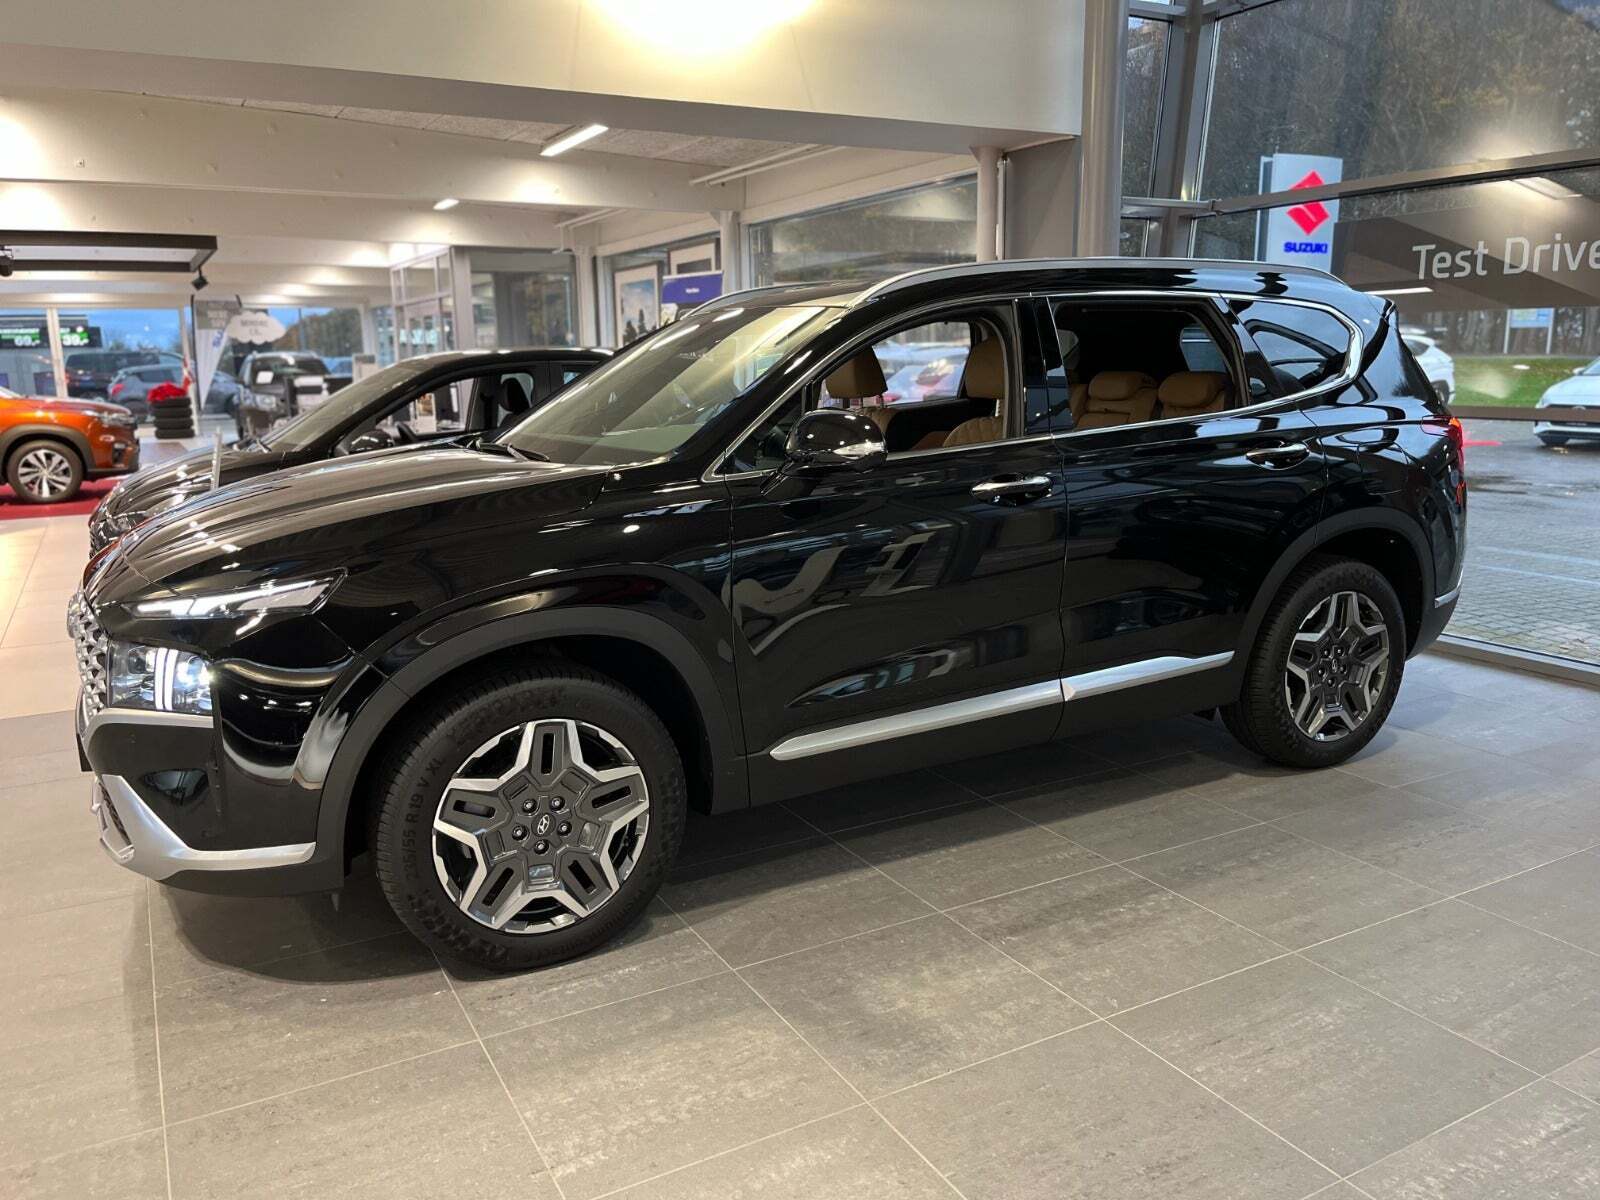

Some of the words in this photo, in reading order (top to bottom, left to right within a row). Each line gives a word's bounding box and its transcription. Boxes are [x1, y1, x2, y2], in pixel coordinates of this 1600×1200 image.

[1283, 241, 1328, 254] SUZUKI
[1412, 240, 1489, 281] Test
[1503, 232, 1600, 275] Drive
